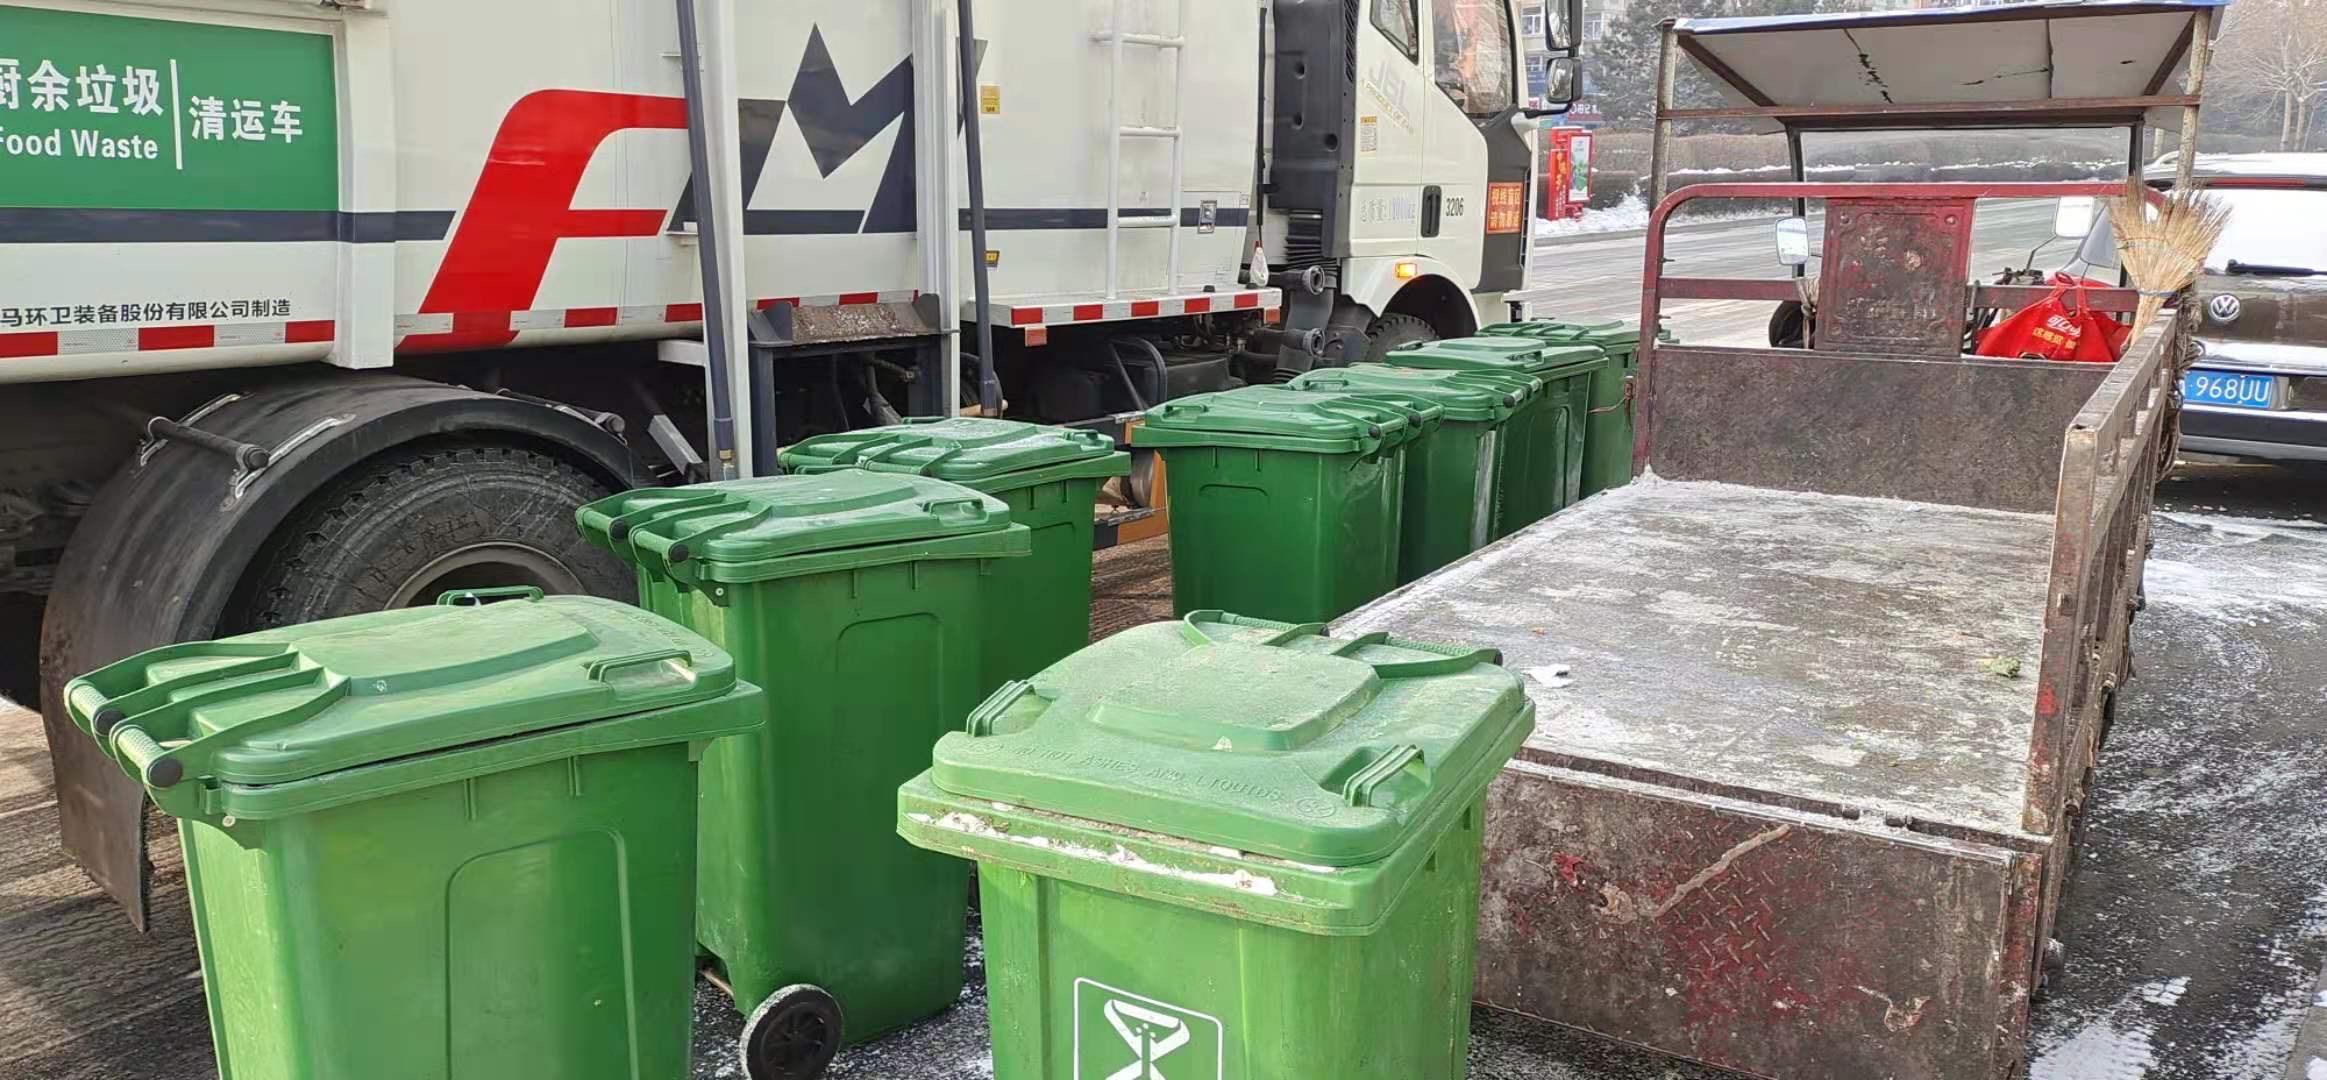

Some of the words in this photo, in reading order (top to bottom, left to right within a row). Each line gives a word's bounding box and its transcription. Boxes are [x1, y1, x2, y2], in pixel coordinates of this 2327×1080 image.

[189, 95, 304, 144] 清运车
[71, 129, 159, 160] Waste
[1445, 197, 1465, 217] 3206
[0, 299, 292, 328] 马环卫装备股份有限公司制造
[1079, 752, 1140, 776] ASHES
[1195, 774, 1285, 802] LIQUIDS
